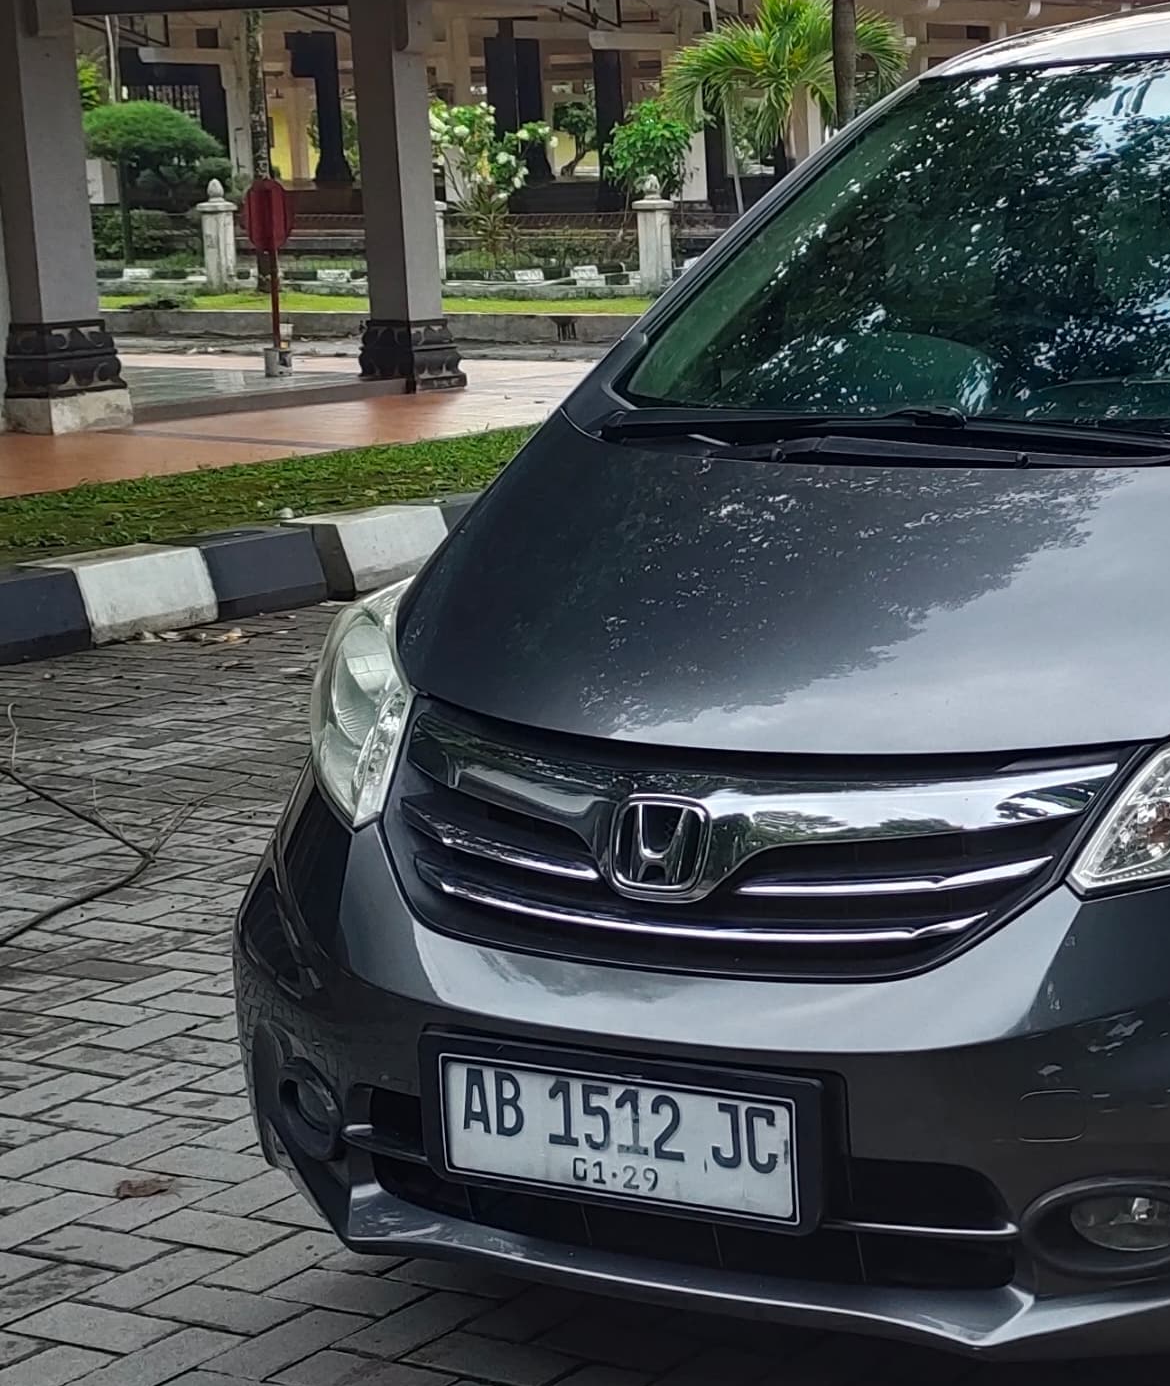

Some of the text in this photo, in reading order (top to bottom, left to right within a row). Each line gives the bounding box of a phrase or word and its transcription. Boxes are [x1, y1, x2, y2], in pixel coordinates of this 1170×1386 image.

[463, 1068, 778, 1174] AB 1512 JC
